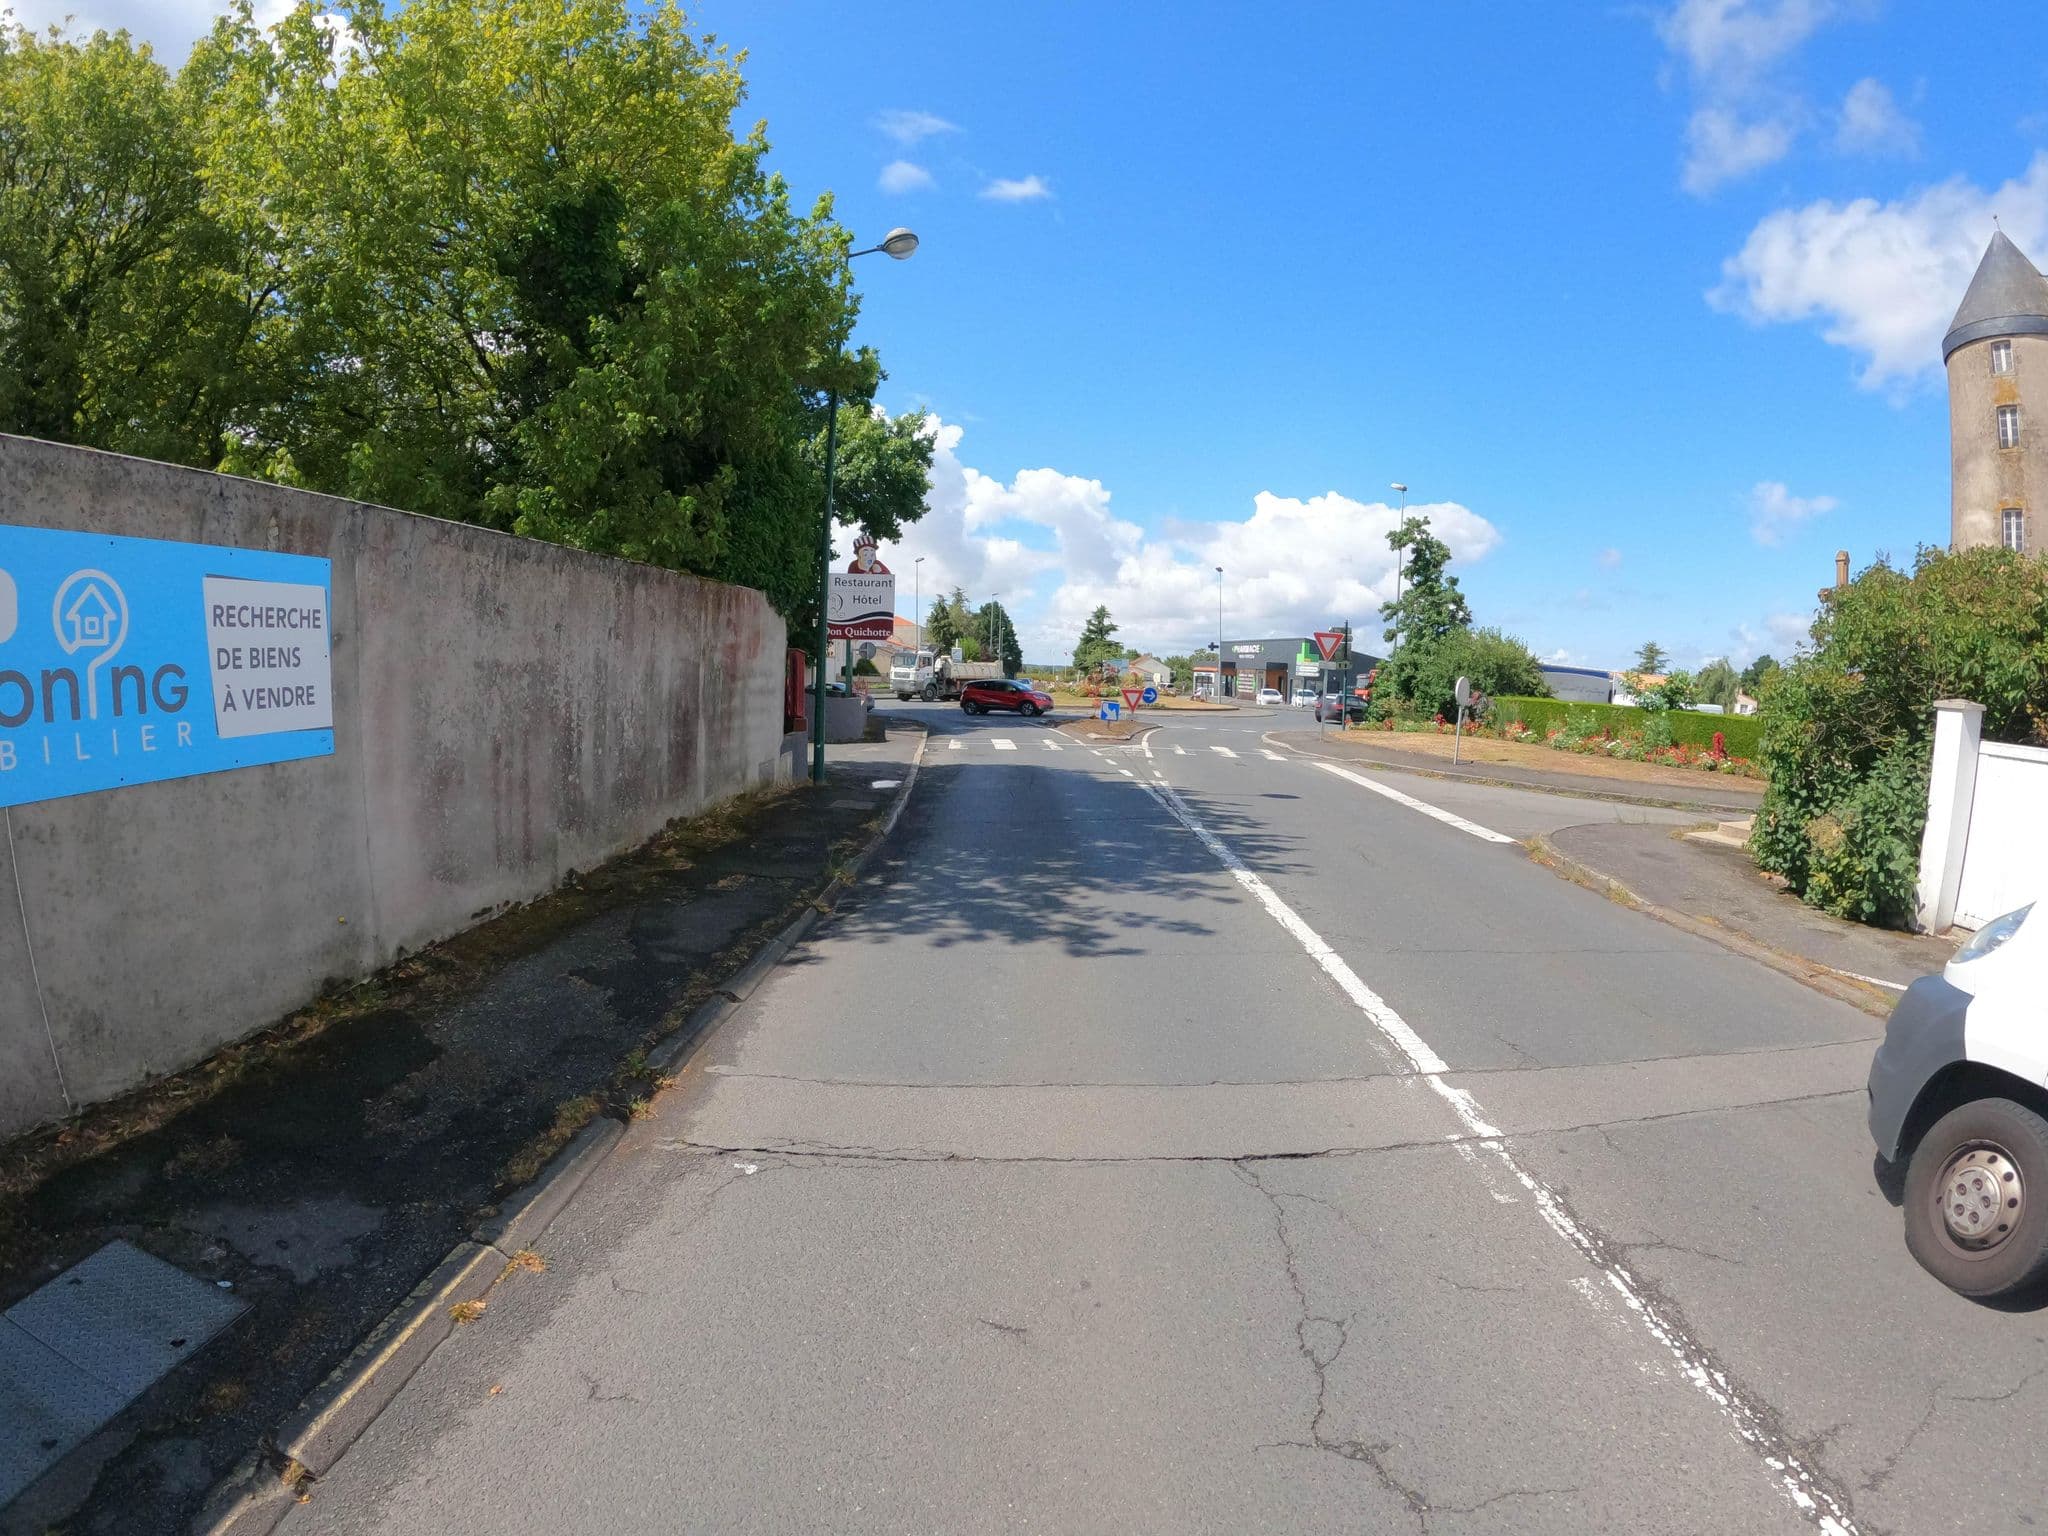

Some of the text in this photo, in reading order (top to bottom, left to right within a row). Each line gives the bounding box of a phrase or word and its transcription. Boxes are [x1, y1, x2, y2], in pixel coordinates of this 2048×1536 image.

[835, 578, 892, 587] Restaurant
[853, 595, 882, 604] Hôtel
[212, 605, 321, 629] RECHERCHE
[845, 627, 890, 637] Quichotte
[217, 647, 301, 670] DE BIENS
[223, 684, 315, 712] À VENDRE
[0, 721, 193, 771] BILIER
